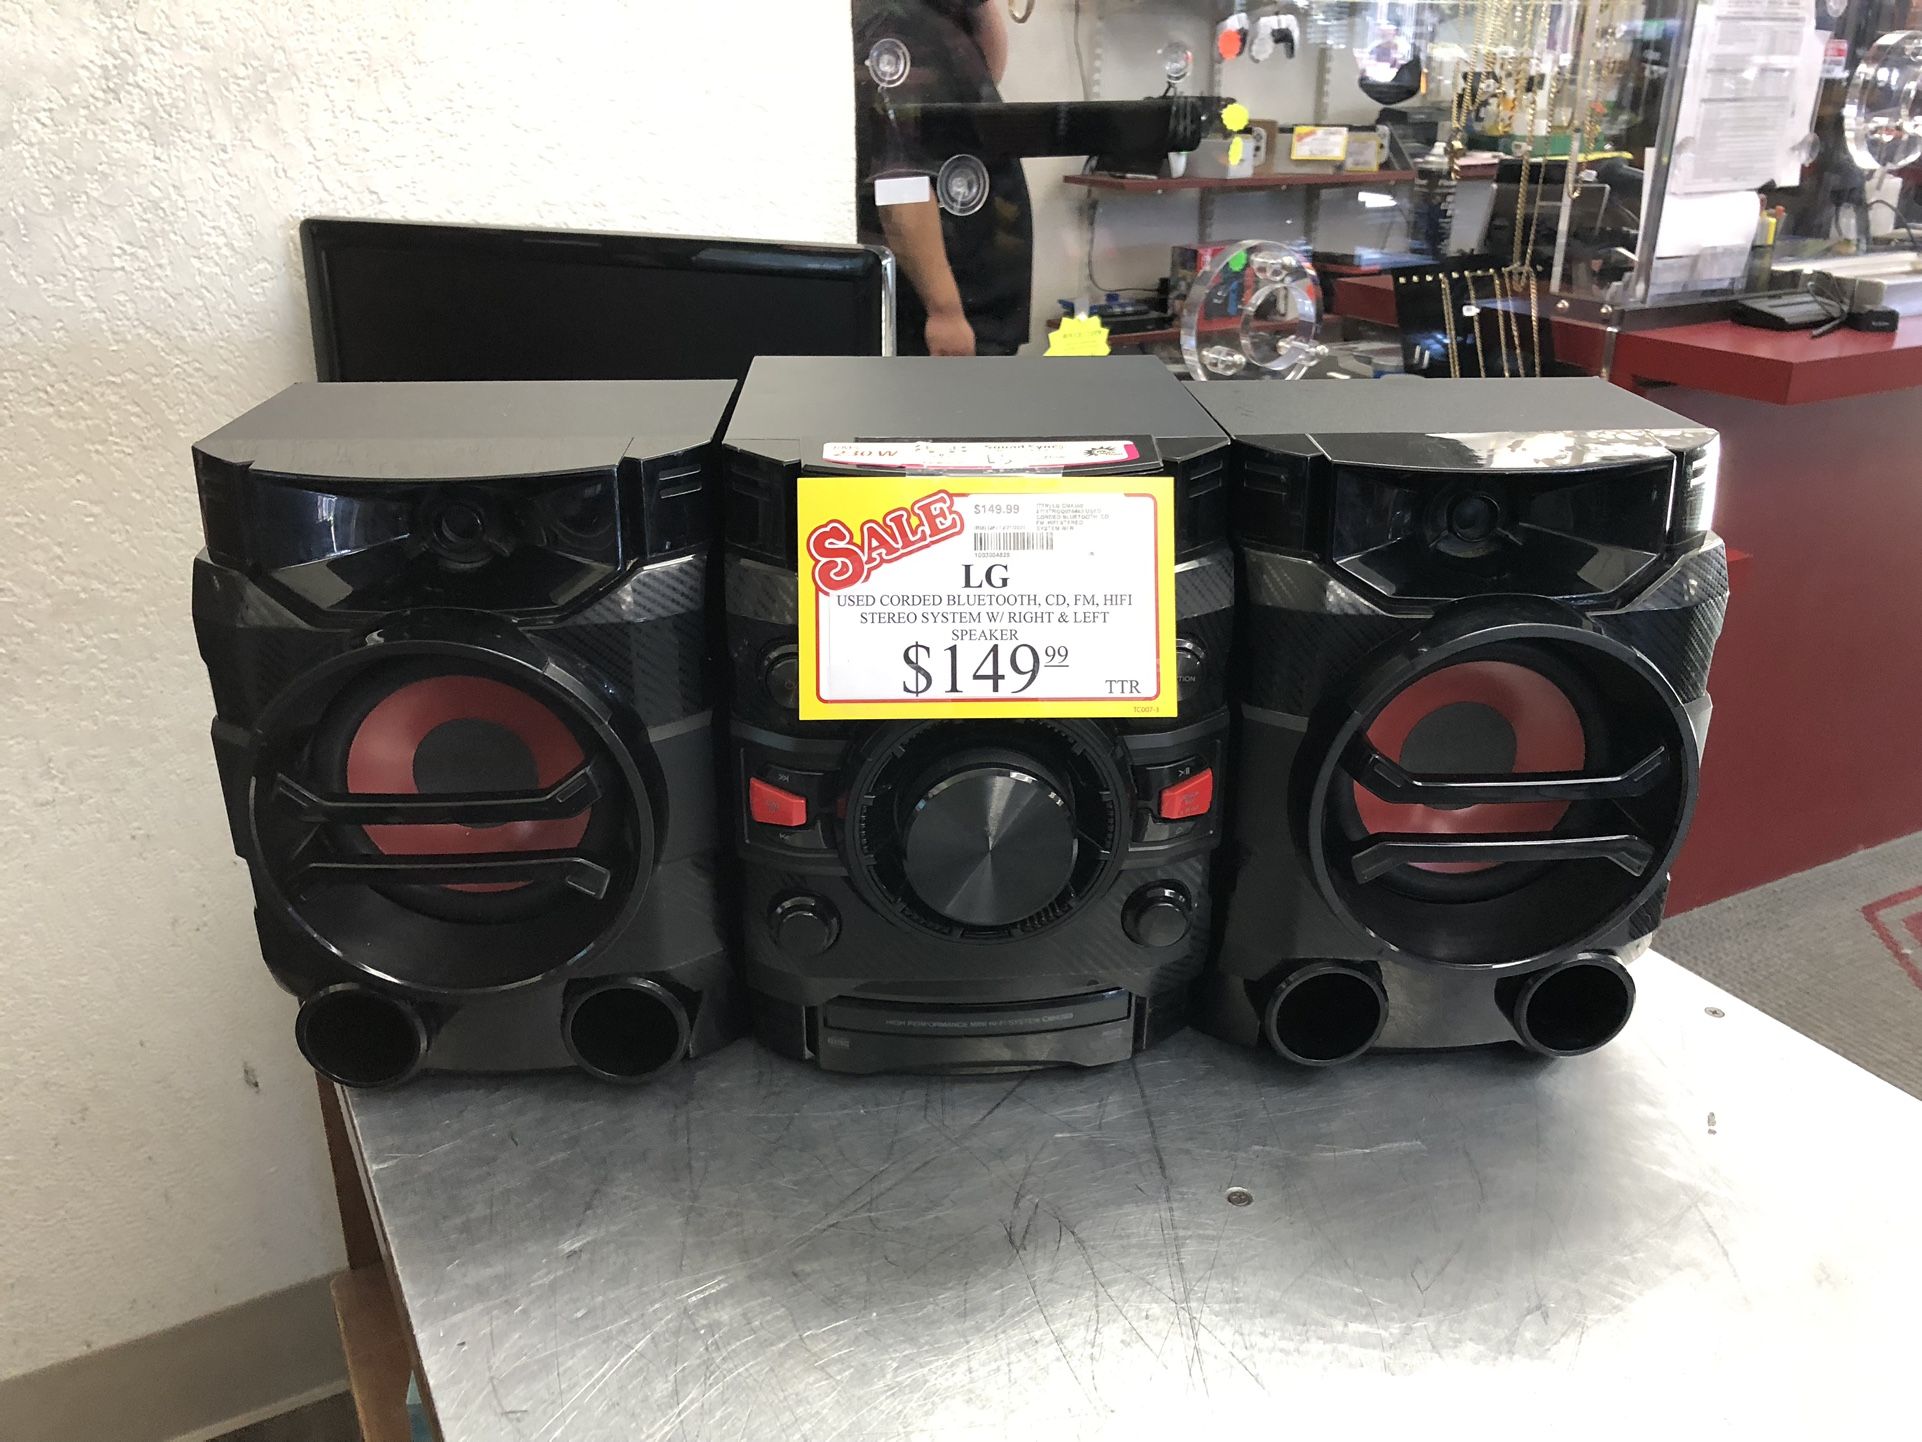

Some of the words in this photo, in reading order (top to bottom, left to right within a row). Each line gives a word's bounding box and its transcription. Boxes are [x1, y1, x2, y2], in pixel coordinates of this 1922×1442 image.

[973, 503, 1021, 515] $149.99
[806, 489, 965, 596] SALE
[962, 563, 1011, 589] LG
[836, 594, 876, 607] USED
[880, 593, 942, 607] CORDED
[947, 593, 1042, 609] BLUETOOTH,
[1045, 593, 1070, 608] CD,
[1073, 593, 1100, 608] FM,
[1103, 593, 1133, 606] HIFI
[860, 611, 917, 624] STEREO
[921, 611, 982, 624] SYSTEM
[986, 611, 1005, 624] W/
[1007, 611, 1055, 624] RIGHT
[1057, 611, 1069, 624] &
[1073, 611, 1110, 624] LEFT
[951, 628, 1019, 642] SPEAKER
[1105, 679, 1142, 694] TTR
